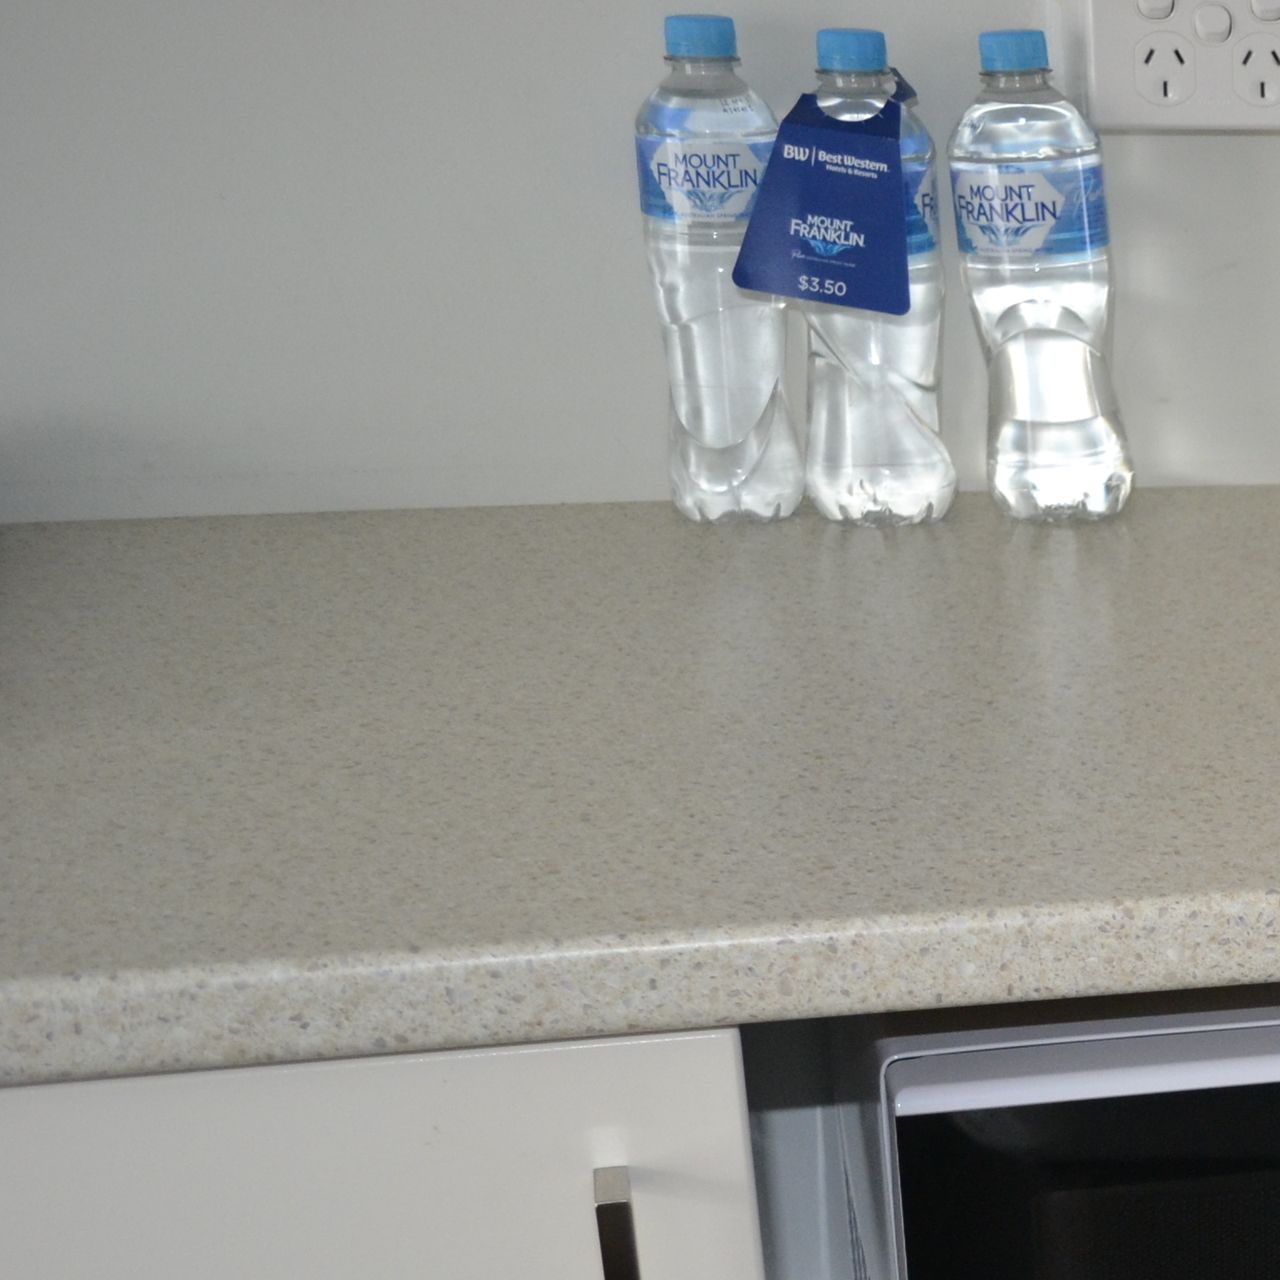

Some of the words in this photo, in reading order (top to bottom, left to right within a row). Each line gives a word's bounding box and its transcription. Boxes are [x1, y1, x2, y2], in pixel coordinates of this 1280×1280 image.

[674, 153, 740, 170] MOUNT
[783, 144, 810, 161] BW
[818, 150, 842, 165] Best
[843, 155, 888, 172] Western
[656, 163, 757, 192] FRANKLIN
[826, 164, 846, 175] Hotels
[854, 168, 878, 179] Resorts
[969, 184, 1035, 202] MOUNT
[957, 195, 1057, 224] FRANKLIN
[790, 219, 865, 247] FRANKLIN
[807, 214, 853, 232] MOUNT
[798, 274, 847, 296] $3.50
